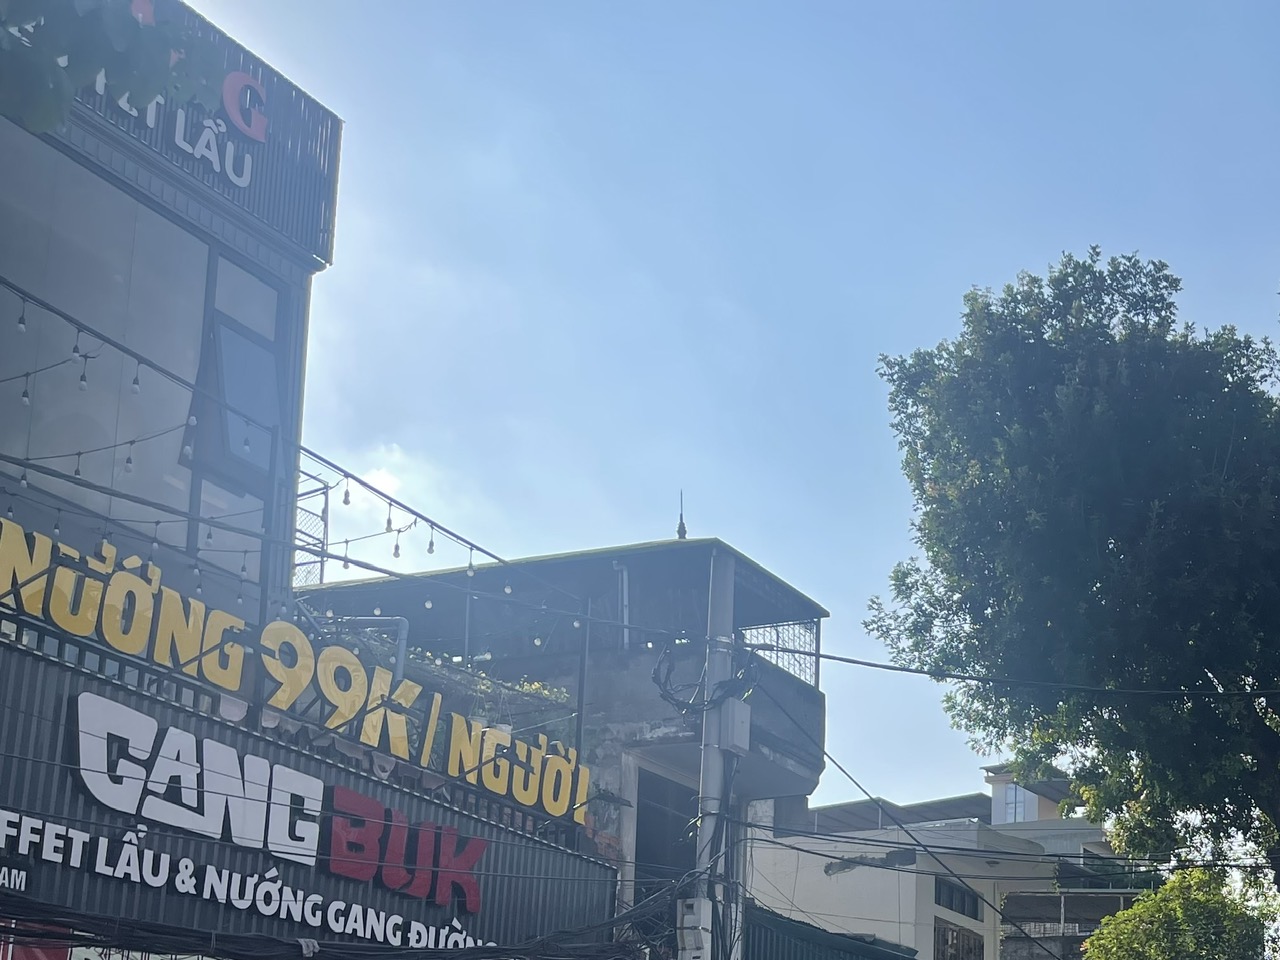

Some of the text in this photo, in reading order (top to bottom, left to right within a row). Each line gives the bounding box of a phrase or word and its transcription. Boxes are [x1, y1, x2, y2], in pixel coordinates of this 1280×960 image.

[175, 107, 252, 188] LẨU
[0, 518, 246, 692] NƯỚNG
[95, 823, 171, 888] LẨU
[175, 857, 197, 896] &
[203, 864, 323, 927] NƯỚNG
[327, 899, 404, 947] GANG
